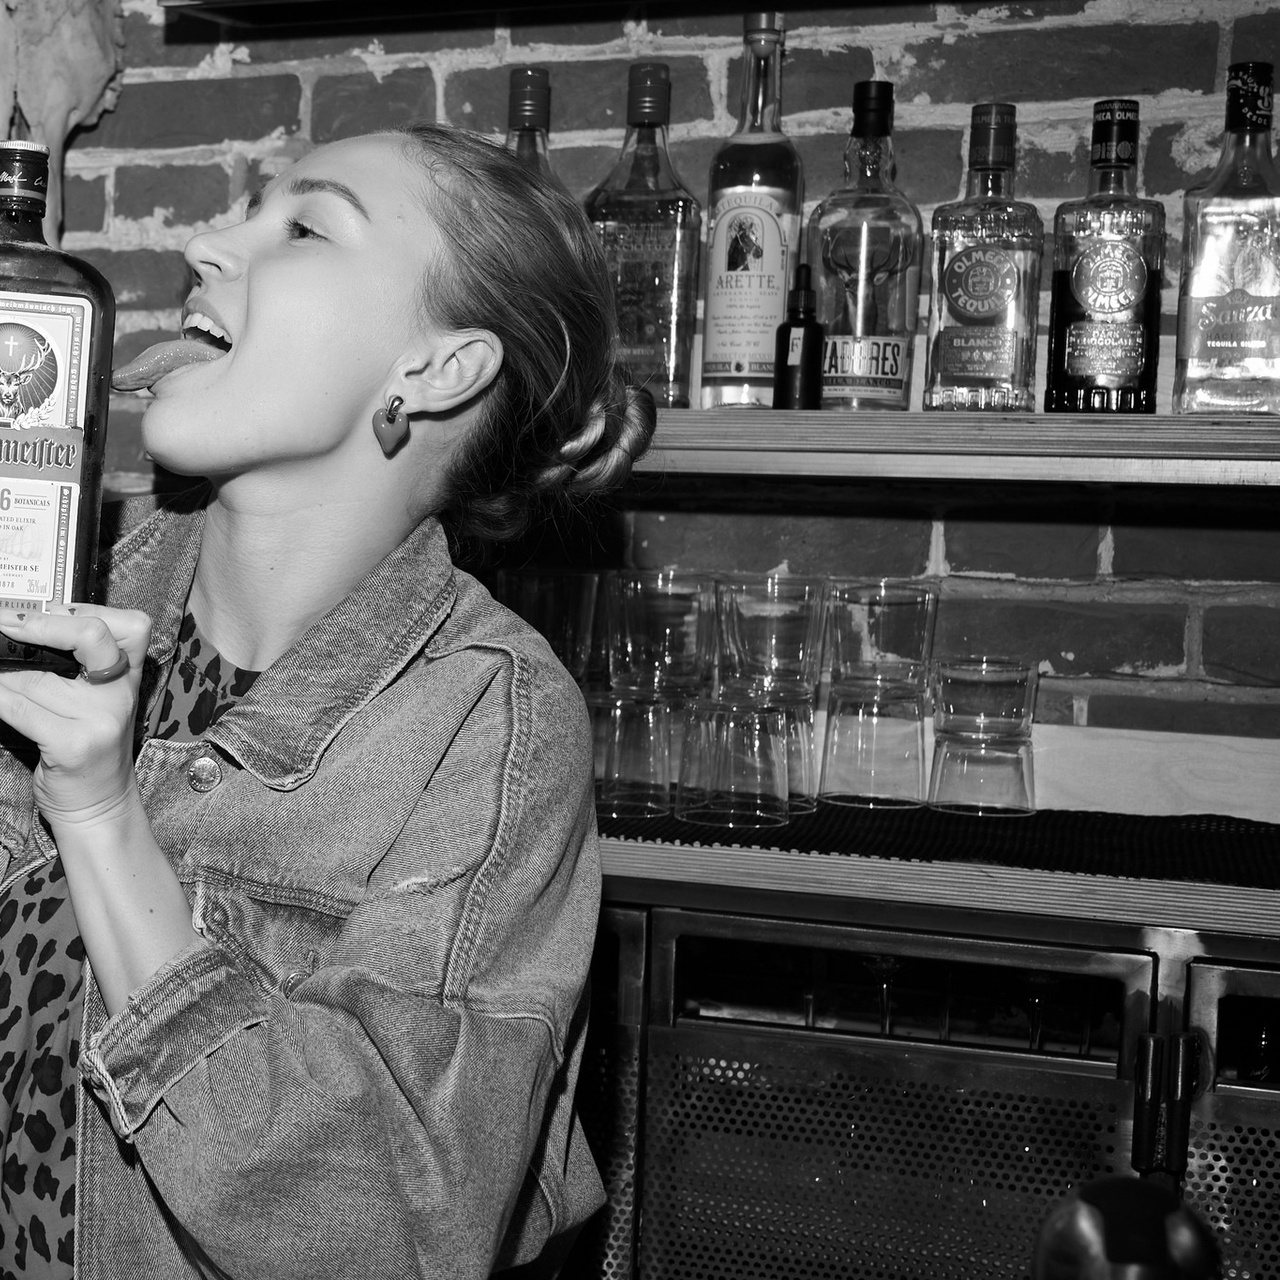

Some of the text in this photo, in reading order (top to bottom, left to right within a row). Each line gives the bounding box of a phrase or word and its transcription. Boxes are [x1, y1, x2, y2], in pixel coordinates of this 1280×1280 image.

[1115, 111, 1138, 121] OLMEC
[715, 274, 776, 289] ARETTE
[1206, 340, 1238, 348] TEQUILA
[823, 341, 900, 376] ZADORES
[14, 497, 51, 507] BOTANICALS
[15, 516, 36, 524] ELIXIR
[11, 524, 24, 532] OAK
[29, 564, 40, 573] SE
